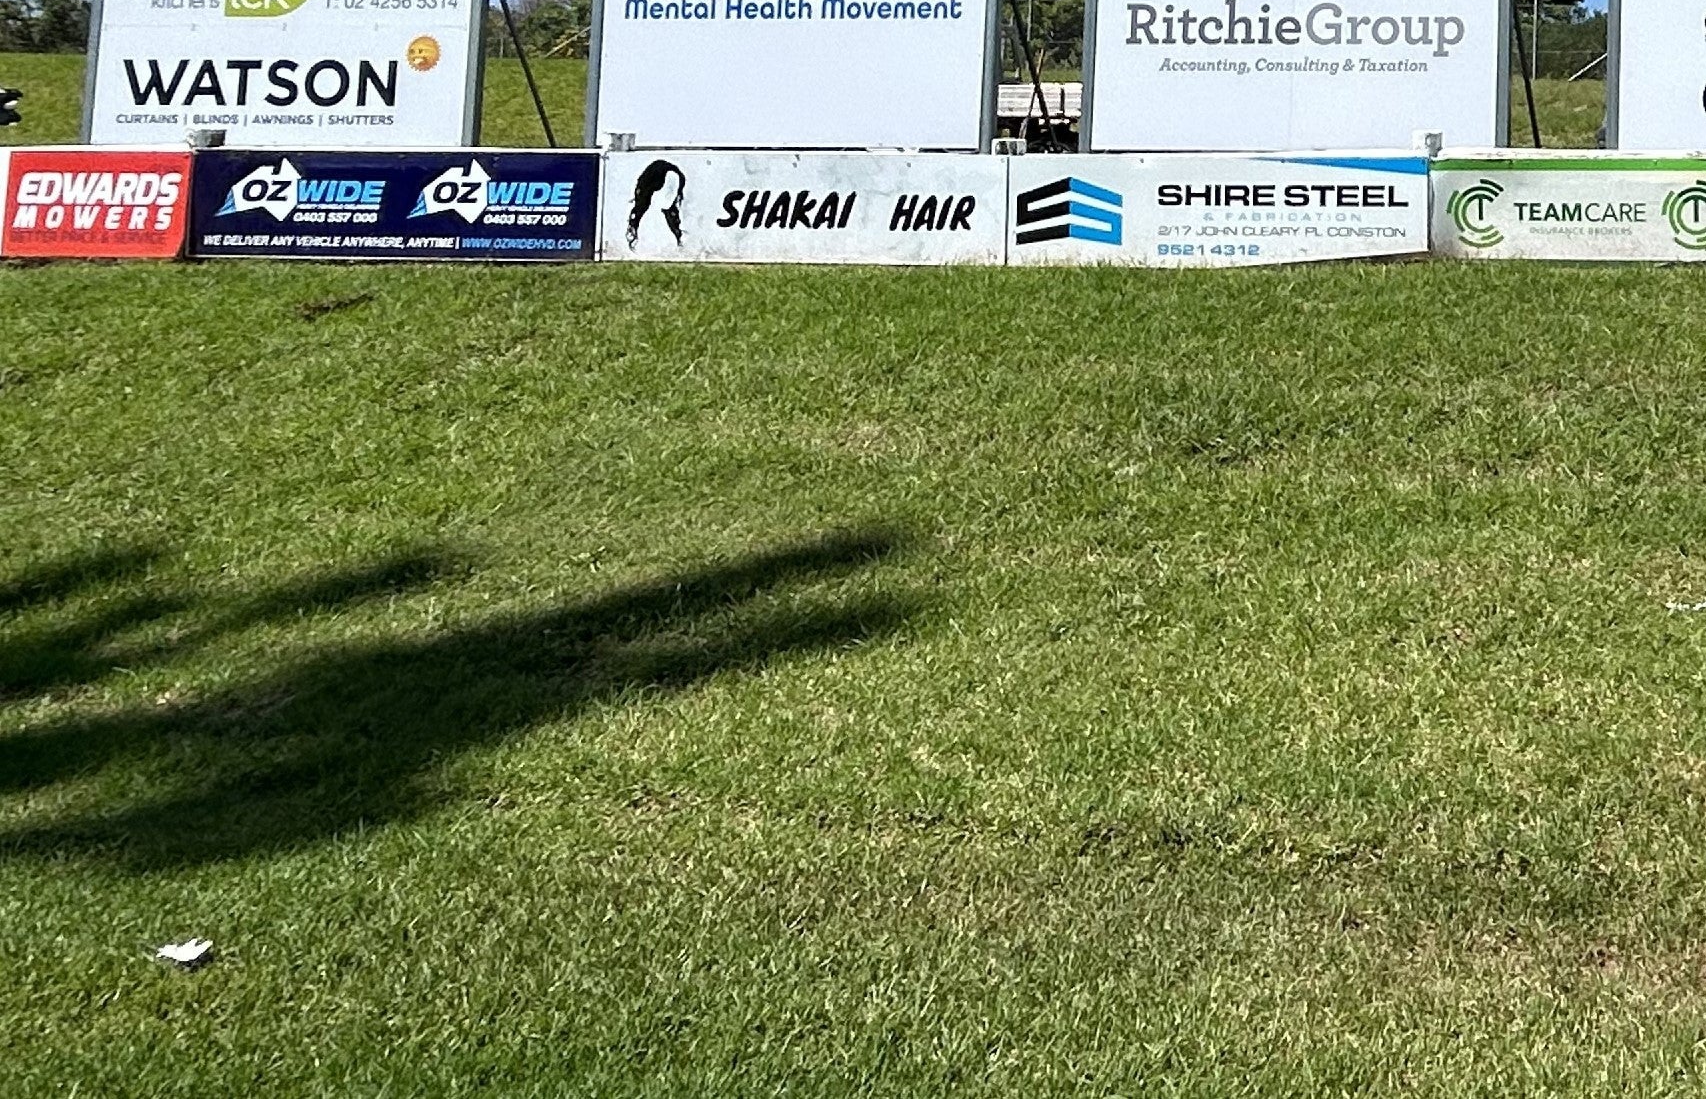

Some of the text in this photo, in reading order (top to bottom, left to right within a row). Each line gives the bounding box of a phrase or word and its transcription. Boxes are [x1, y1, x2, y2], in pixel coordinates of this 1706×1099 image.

[1158, 57, 1429, 75] Accounting, Consulting & Taxation
[123, 59, 399, 107] WATSON
[116, 114, 394, 126] CURTAINS BLINDS AWNINGS SHUTTERS
[16, 172, 183, 206] EDWARDS
[242, 180, 386, 203] OZ WIDE
[433, 182, 575, 205] OZ WIDE
[1157, 184, 1409, 208] SHIRE STEEL
[12, 205, 174, 230] MOWERS
[716, 190, 976, 231] SHAKAI HAIR
[1225, 212, 1362, 223] FABRICATION
[1513, 202, 1647, 223] TEAMCARE
[203, 235, 221, 246] WE
[223, 235, 270, 246] DELIVER
[270, 235, 295, 246] ANY
[295, 236, 341, 247] VEHICLE
[1157, 225, 1192, 237] 2/17
[1196, 225, 1238, 238] JOHN
[1242, 226, 1301, 238] CLEARY
[1325, 226, 1406, 238] CONISTON
[1530, 226, 1633, 236] INSURANCE BROKERS
